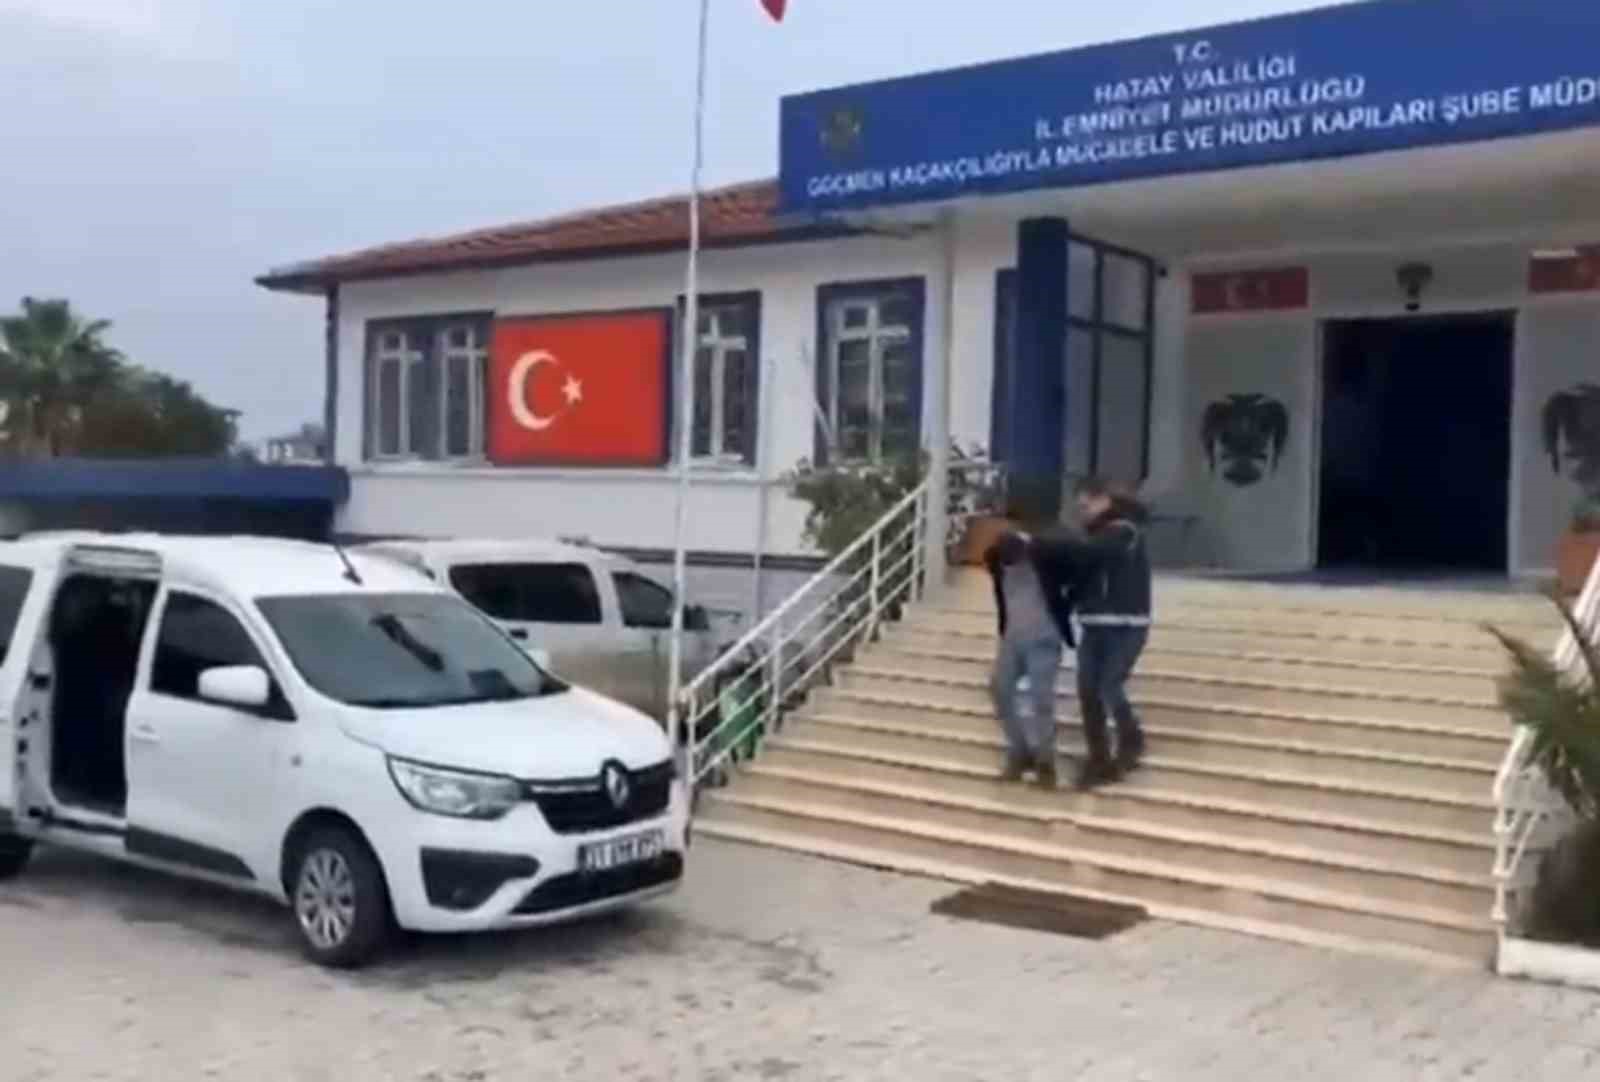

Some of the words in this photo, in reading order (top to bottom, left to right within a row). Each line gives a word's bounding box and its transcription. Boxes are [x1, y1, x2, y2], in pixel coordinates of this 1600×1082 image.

[1094, 73, 1174, 104] HATAY
[1184, 125, 1216, 150] VE
[1221, 116, 1303, 146] HUDUT
[1312, 99, 1435, 136] KAPILARI
[1441, 86, 1522, 123] ŞUBE
